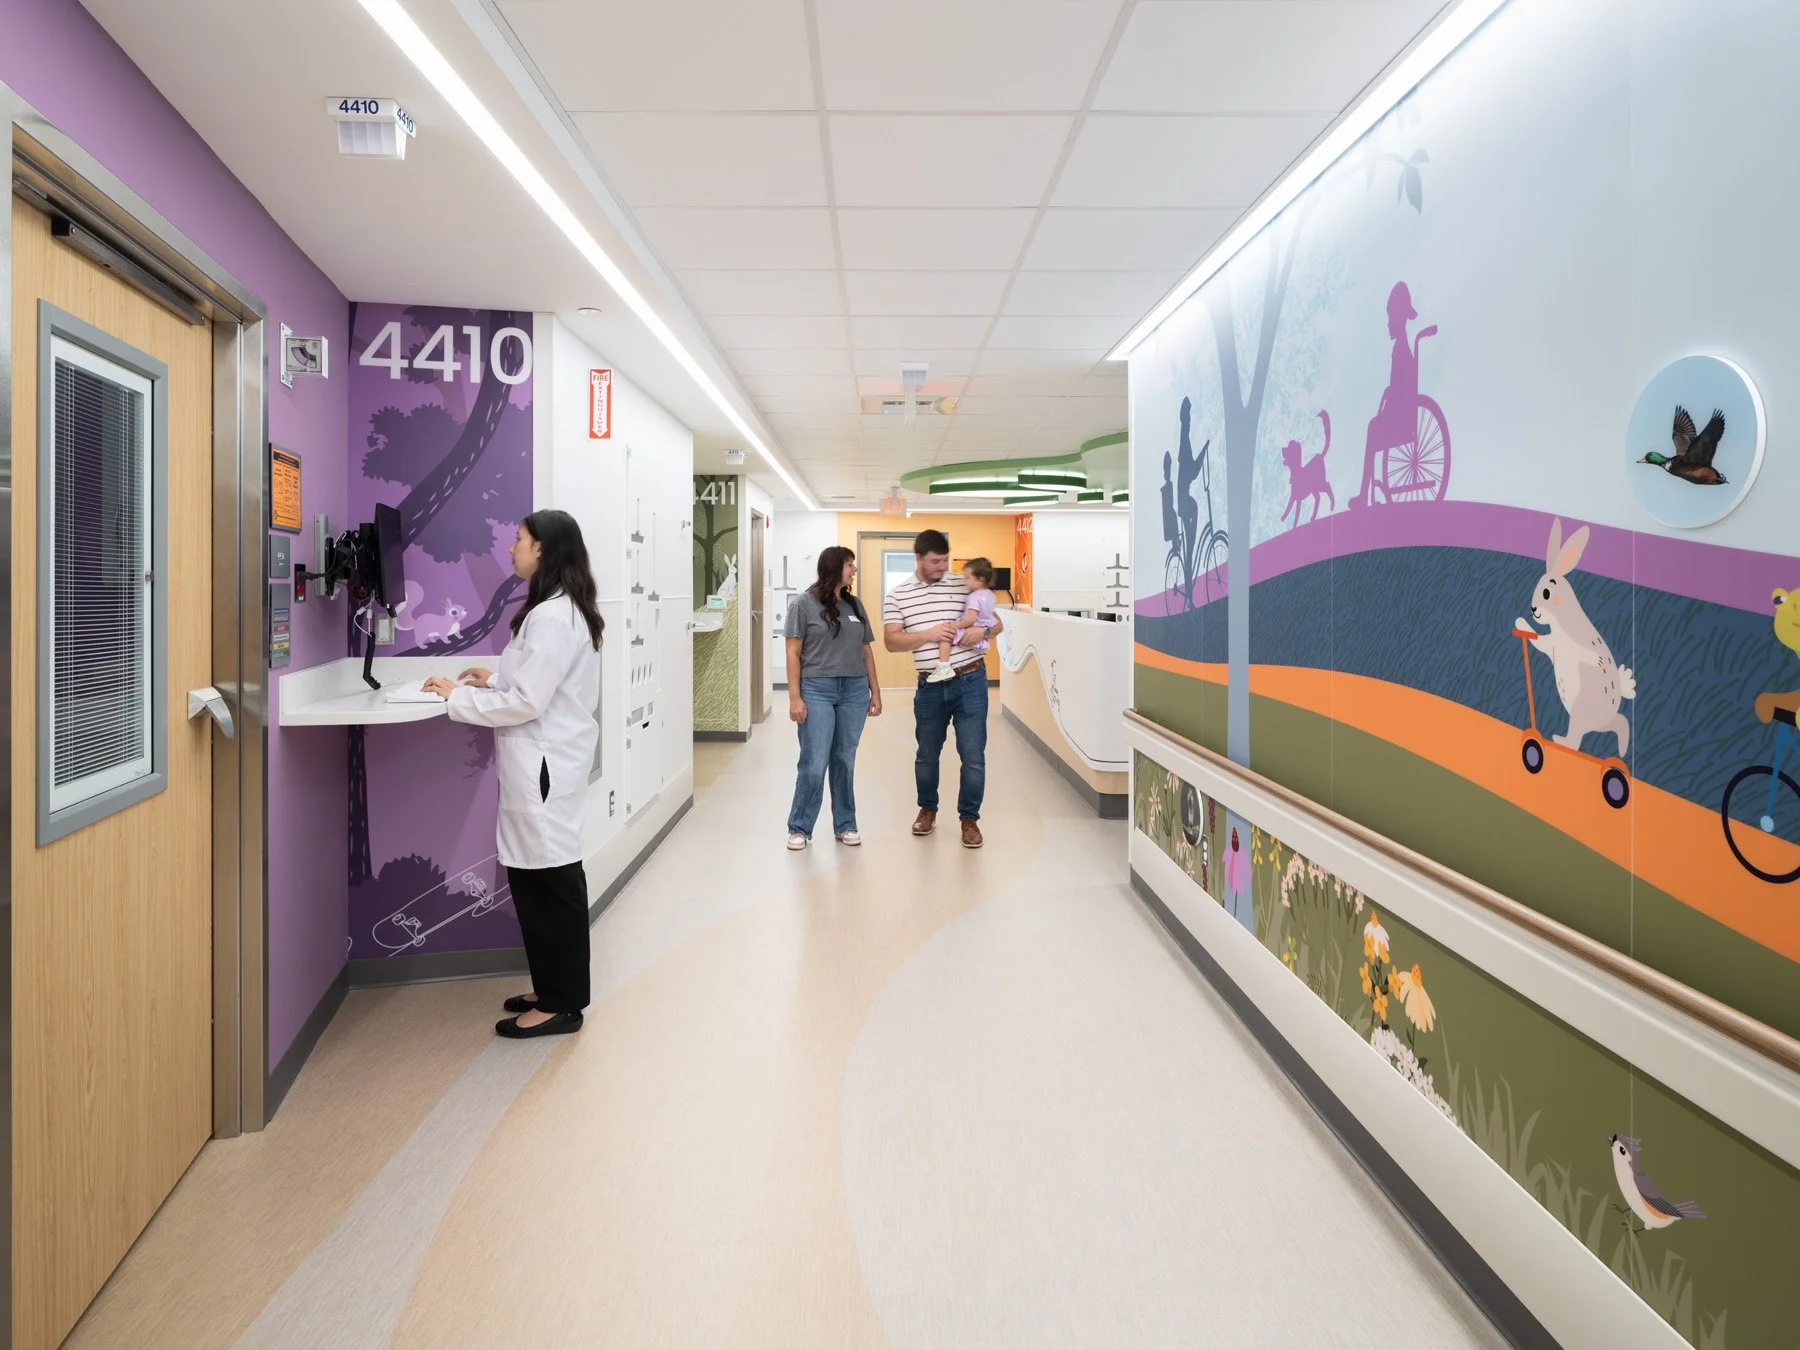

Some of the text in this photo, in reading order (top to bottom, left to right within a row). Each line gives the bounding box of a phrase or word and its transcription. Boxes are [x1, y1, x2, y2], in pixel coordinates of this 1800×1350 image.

[339, 100, 379, 114] 4410
[397, 108, 413, 133] 4410
[359, 321, 533, 385] 4410
